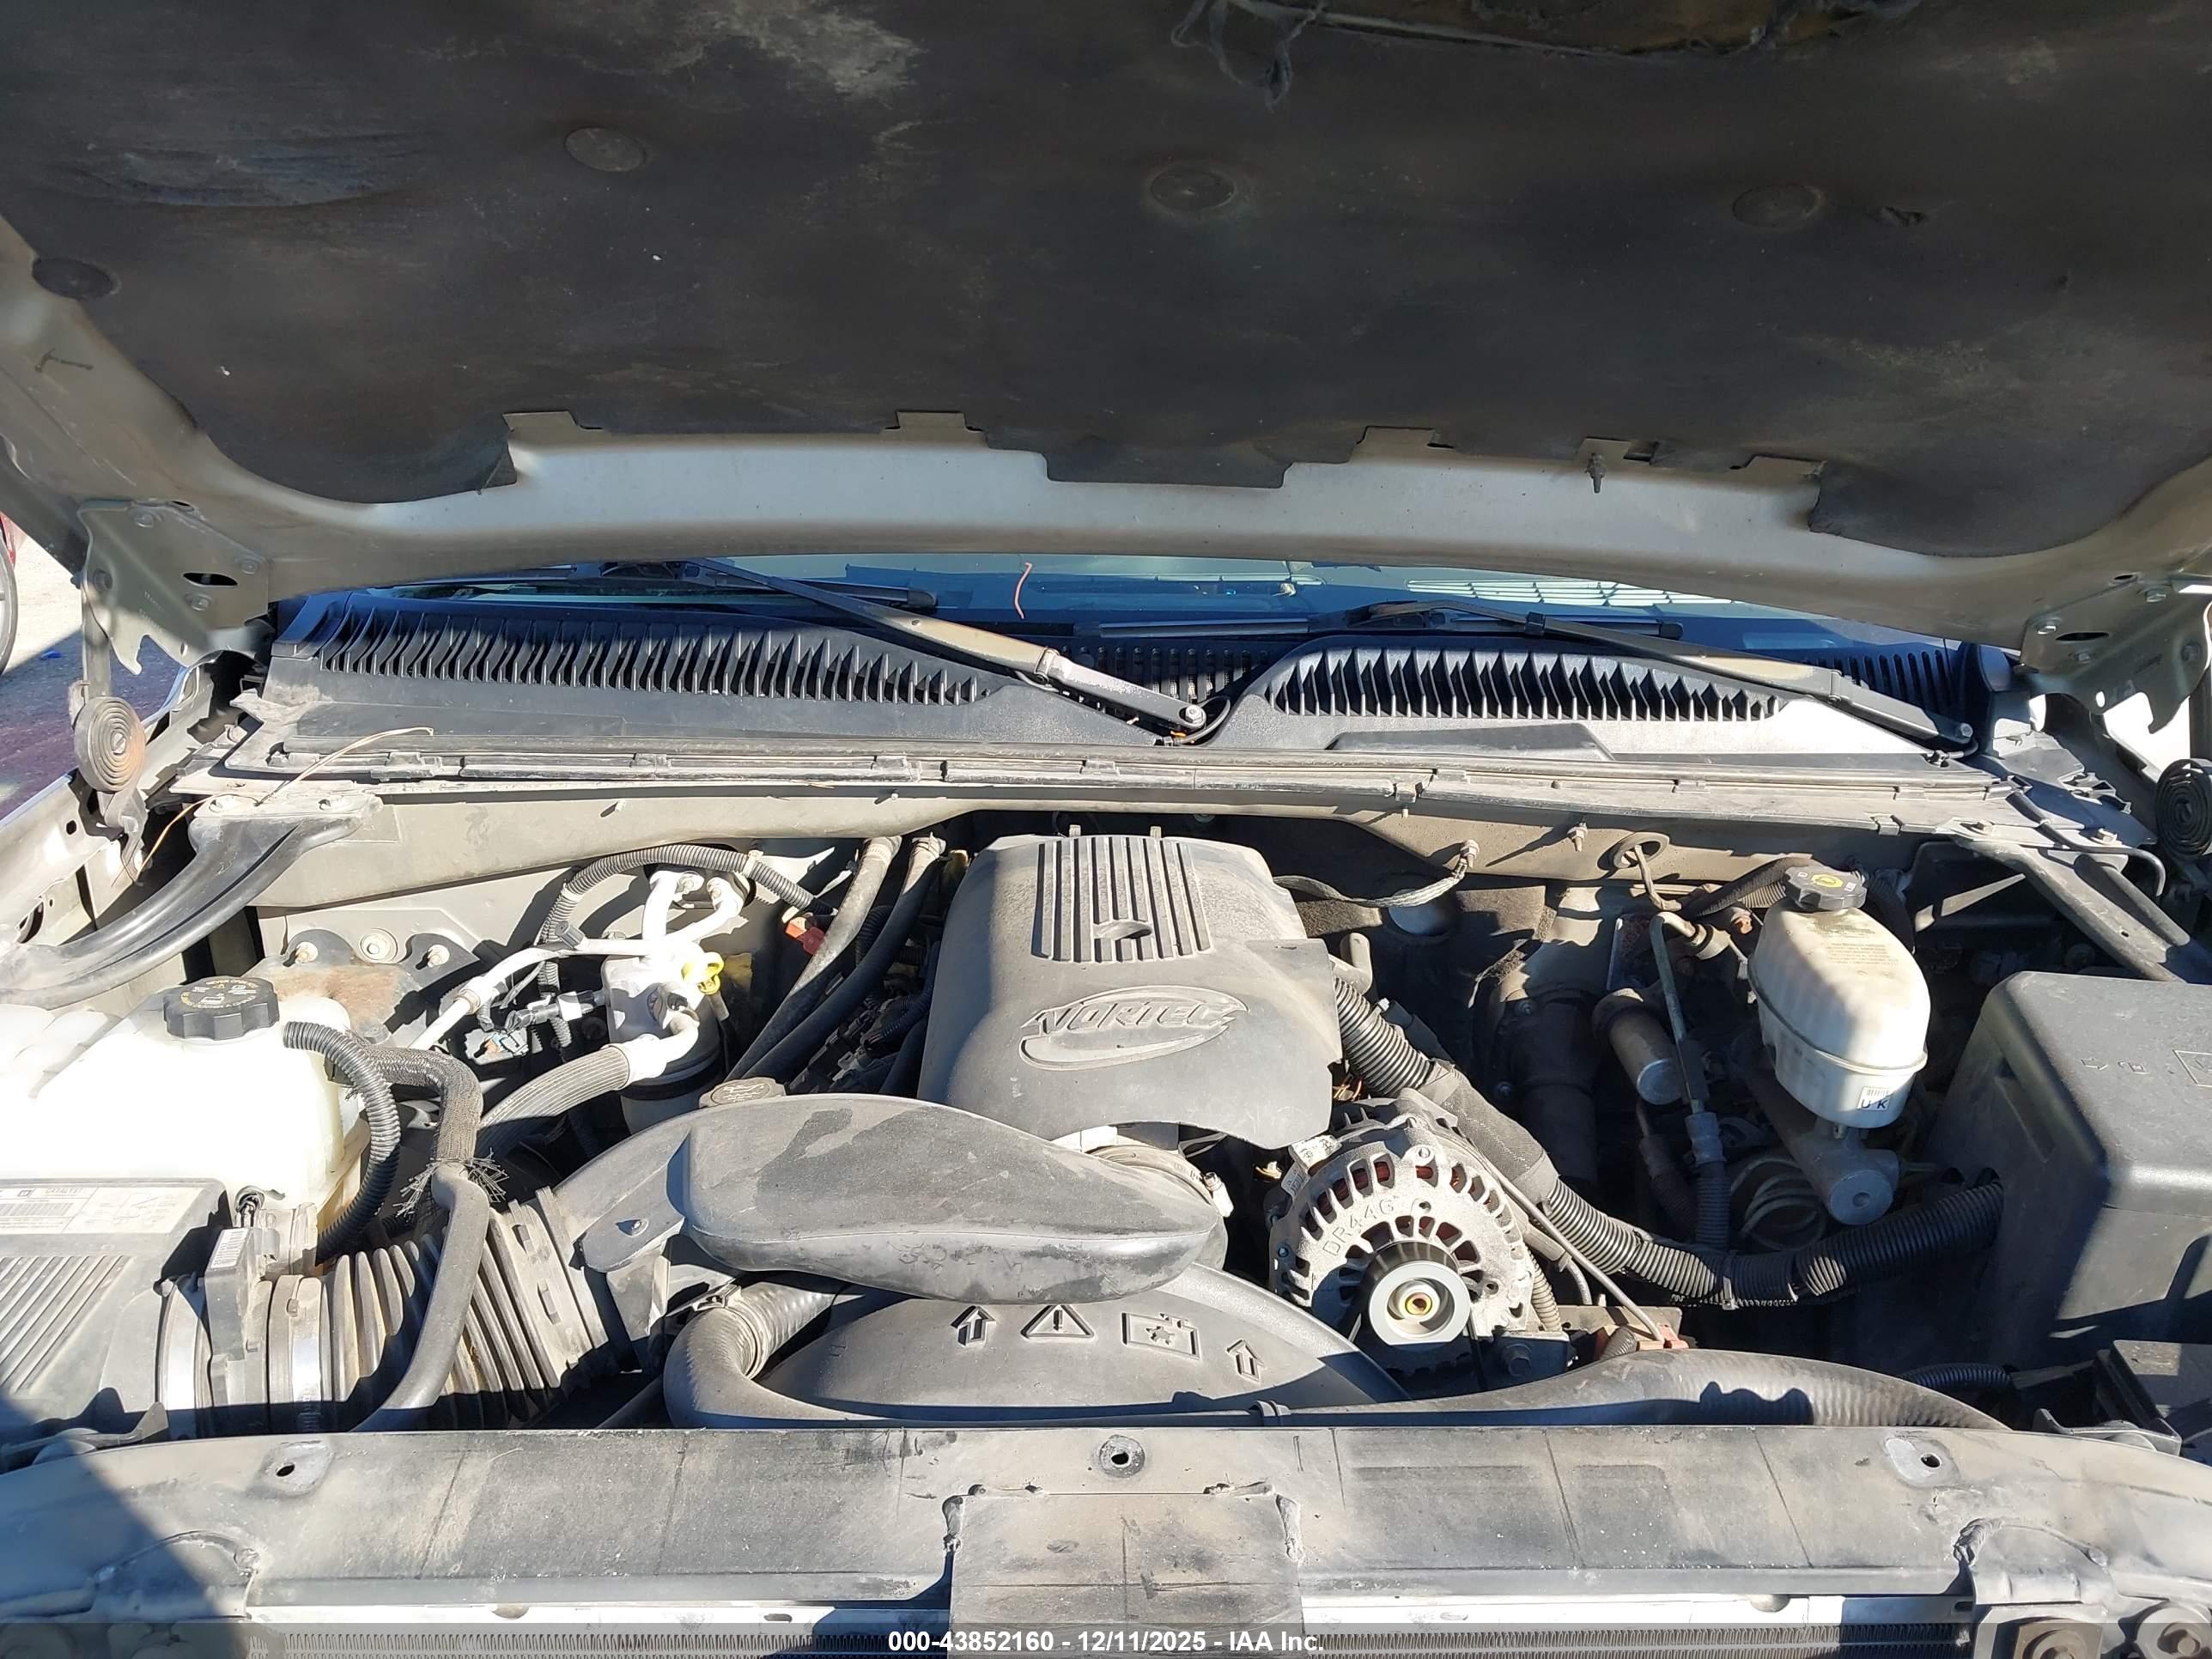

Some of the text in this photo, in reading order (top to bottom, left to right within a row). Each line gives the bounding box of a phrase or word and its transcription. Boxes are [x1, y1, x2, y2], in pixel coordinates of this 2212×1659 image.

[1035, 1000, 1225, 1036] VORTEC
[1861, 1098, 1889, 1109] U K
